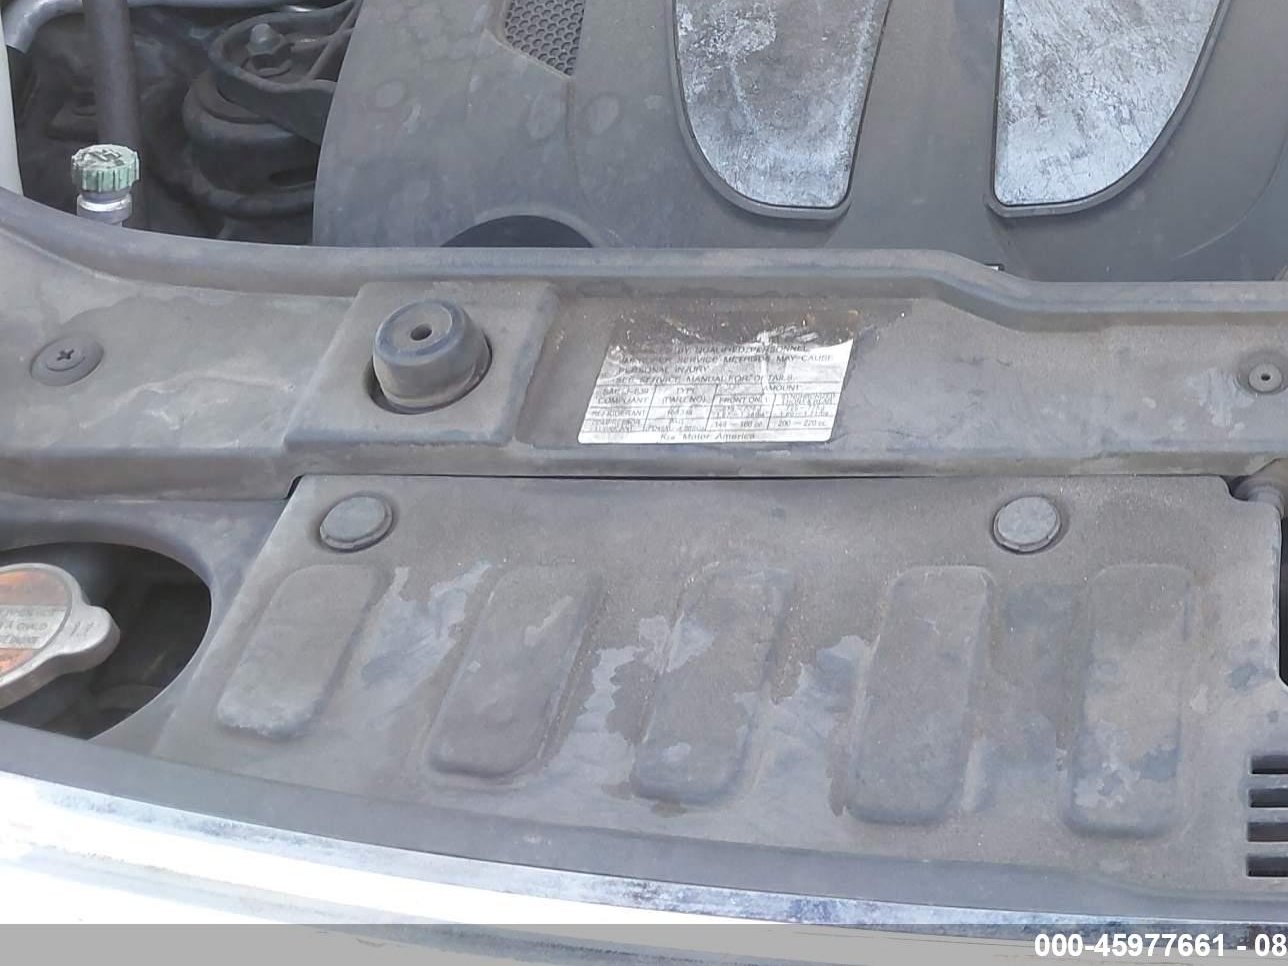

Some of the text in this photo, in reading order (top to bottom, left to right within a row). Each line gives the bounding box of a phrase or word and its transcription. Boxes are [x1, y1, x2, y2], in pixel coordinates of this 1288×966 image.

[775, 354, 795, 363] MAY
[682, 433, 710, 441] Motor
[714, 432, 756, 441] America
